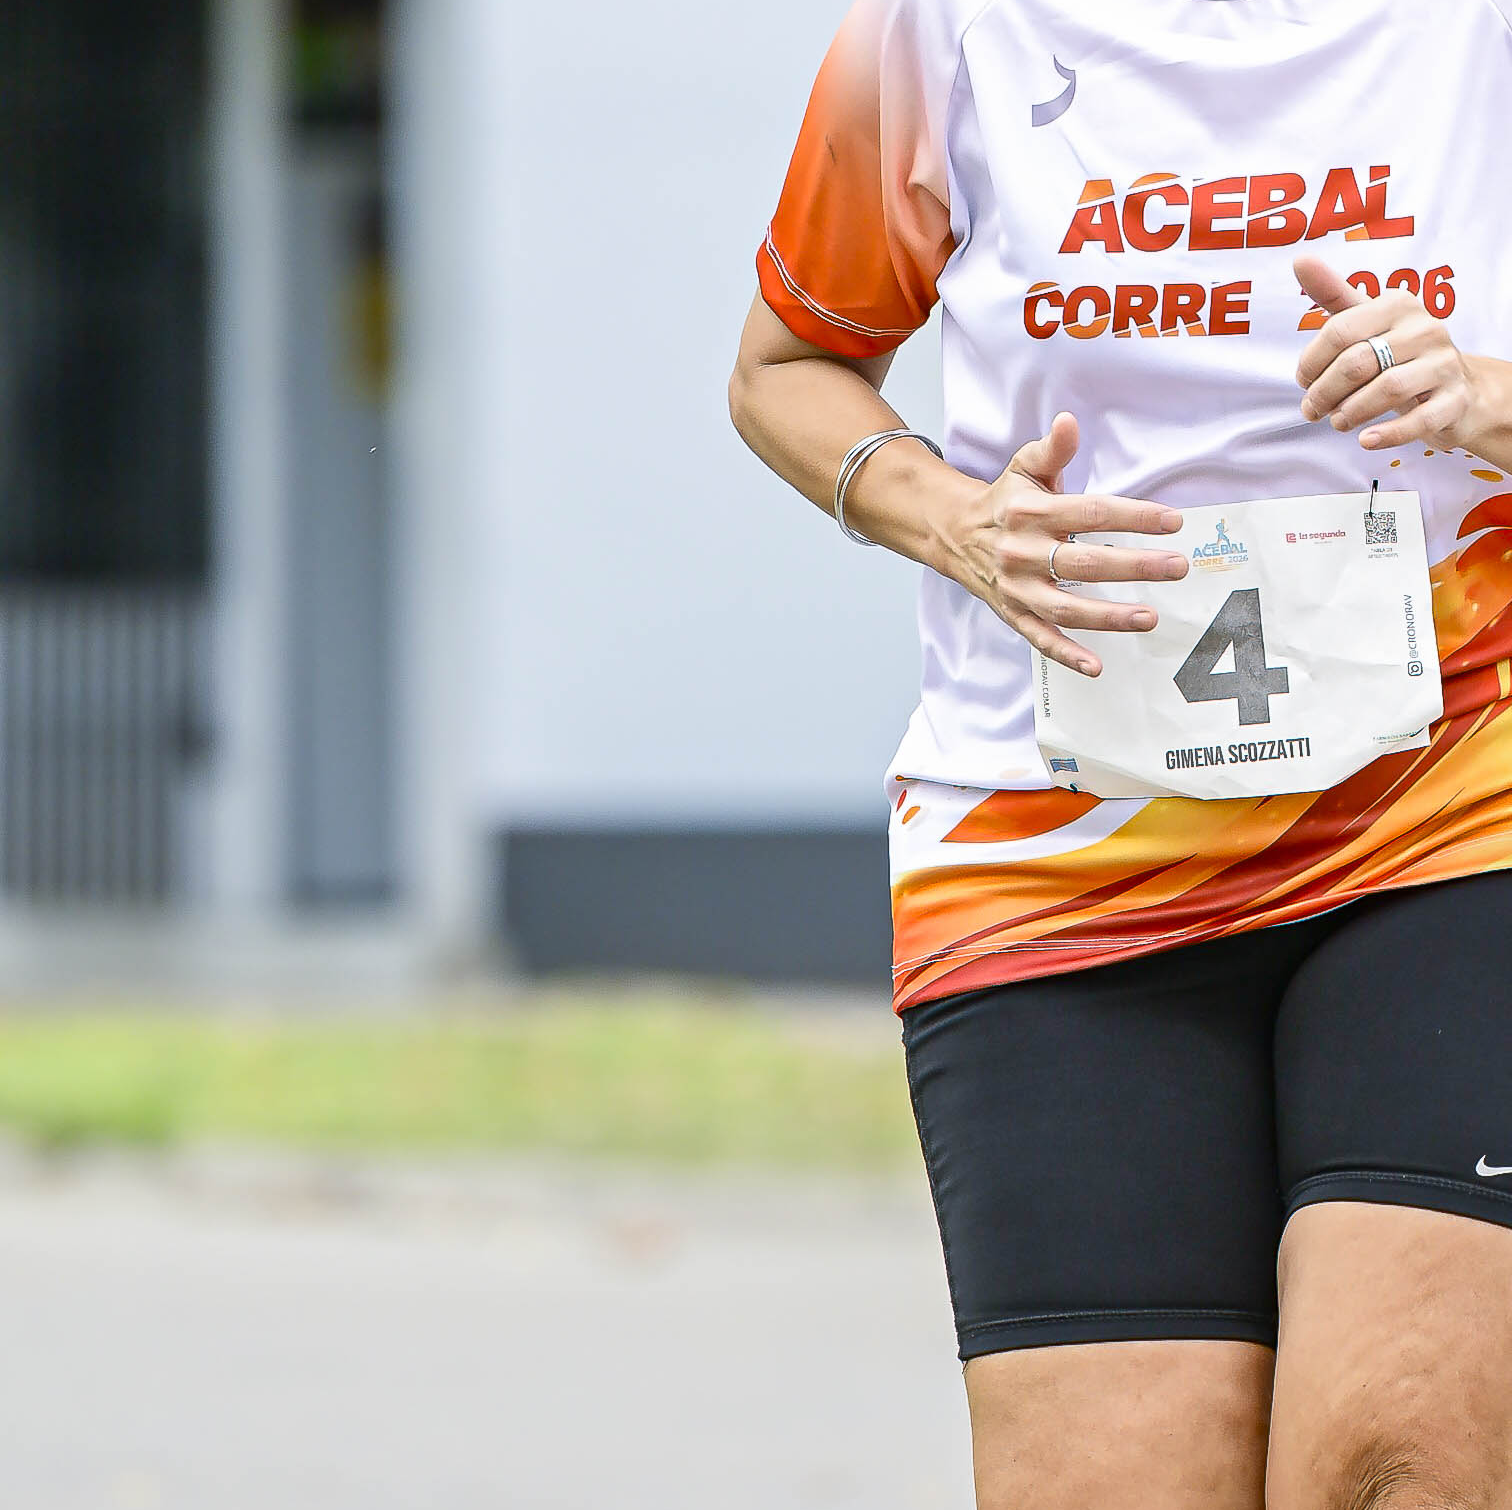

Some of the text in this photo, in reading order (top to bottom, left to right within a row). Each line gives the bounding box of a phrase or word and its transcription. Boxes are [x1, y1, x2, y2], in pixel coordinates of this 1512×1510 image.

[1058, 165, 1414, 253] ACEBAL
[1024, 281, 1251, 339] CORRE
[1193, 542, 1247, 558] ACEBAL
[1193, 556, 1225, 567] CORRE
[1403, 594, 1419, 659] @CRONORAV
[1173, 588, 1289, 725] 4
[1165, 737, 1311, 770] GIMENA SCOZZATTI
